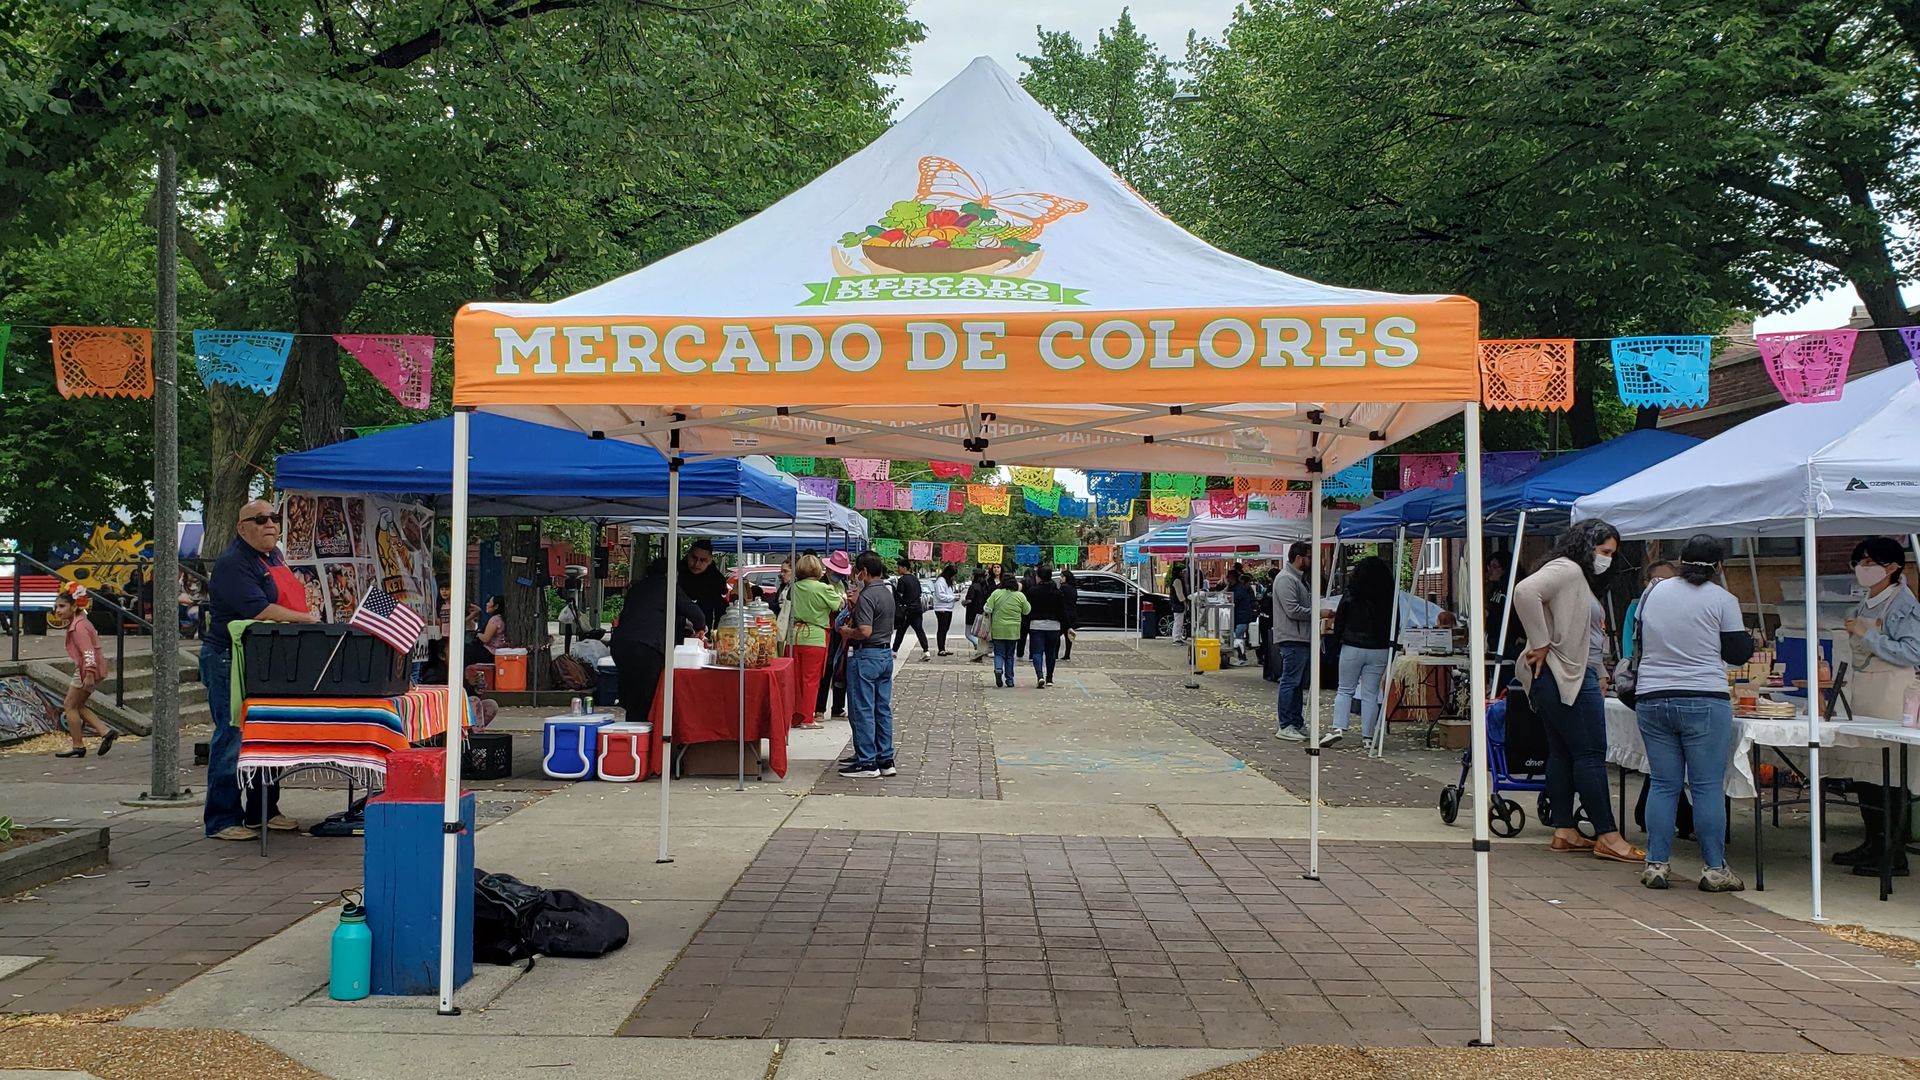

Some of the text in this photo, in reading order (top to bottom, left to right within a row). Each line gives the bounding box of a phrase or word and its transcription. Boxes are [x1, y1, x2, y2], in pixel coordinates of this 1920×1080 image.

[839, 277, 1050, 294] MERCADO
[835, 288, 1050, 300] DE COLORES
[494, 316, 1419, 374] MERCADO DE COLORES
[1525, 758, 1544, 767] drive
